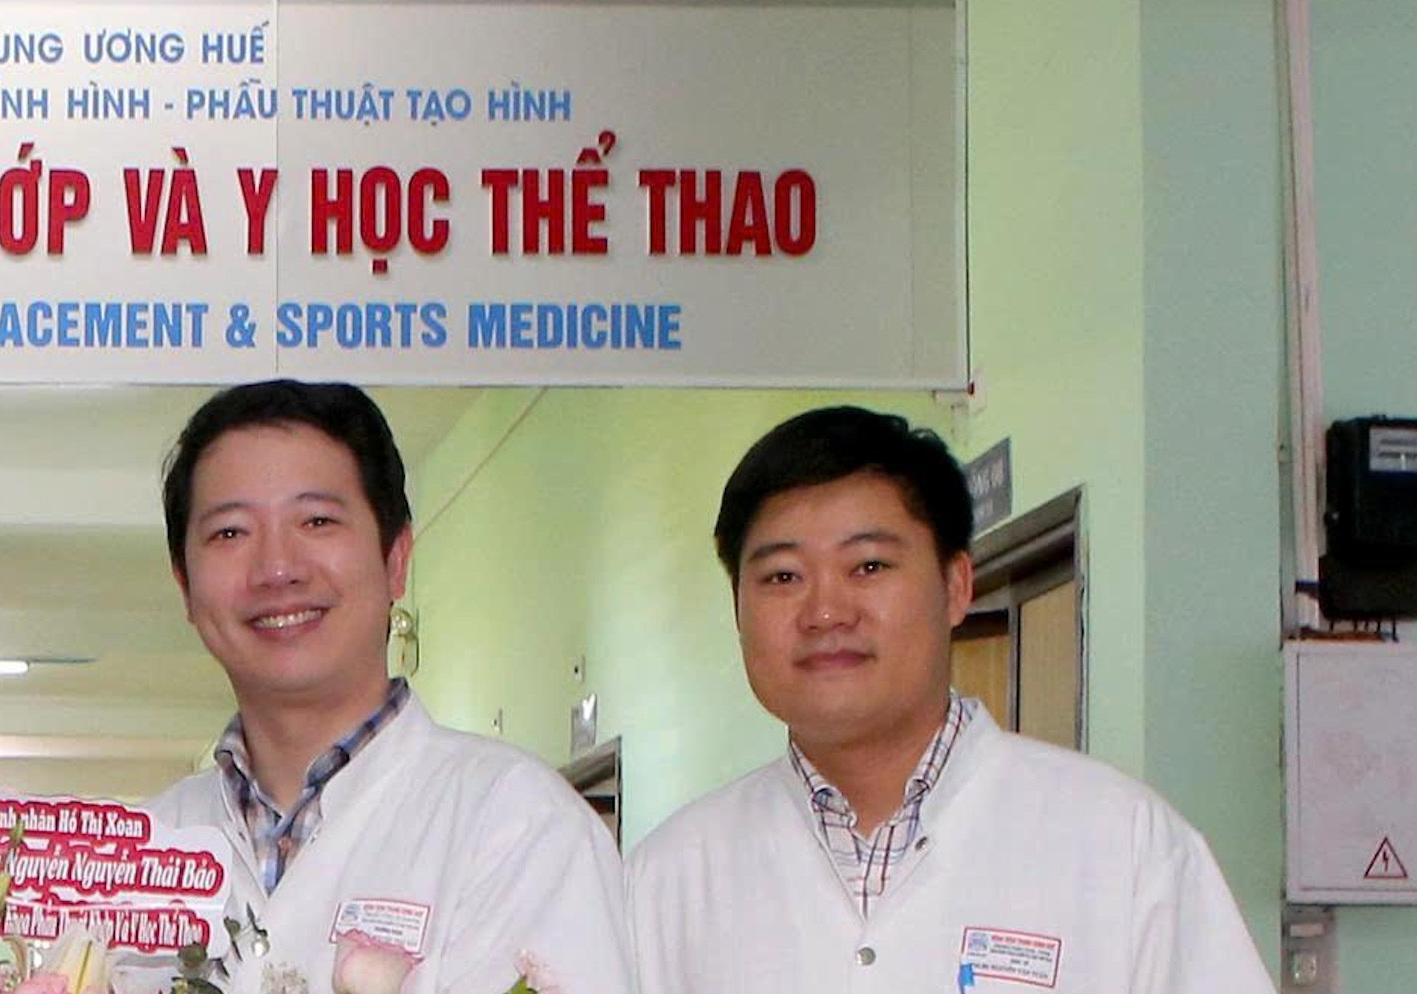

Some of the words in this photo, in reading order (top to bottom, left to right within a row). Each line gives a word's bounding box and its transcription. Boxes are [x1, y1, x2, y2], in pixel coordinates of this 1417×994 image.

[84, 27, 185, 65] ƯƠNG
[201, 21, 272, 65] HUẾ
[66, 81, 151, 121] HÌNH
[186, 79, 279, 121] PHẪU
[292, 82, 396, 127] THUẬT
[406, 88, 472, 127] TẠO
[488, 80, 571, 122] HÌNH
[123, 148, 208, 257] VÀ
[237, 168, 279, 257] Y
[310, 167, 451, 275] HỌC
[480, 130, 616, 257] THỂ
[638, 168, 817, 257] THAO
[225, 303, 257, 348] &
[277, 302, 448, 349] SPORTS
[468, 303, 682, 350] MEDICINE
[81, 811, 102, 839] Thị
[105, 812, 143, 837] Xoan
